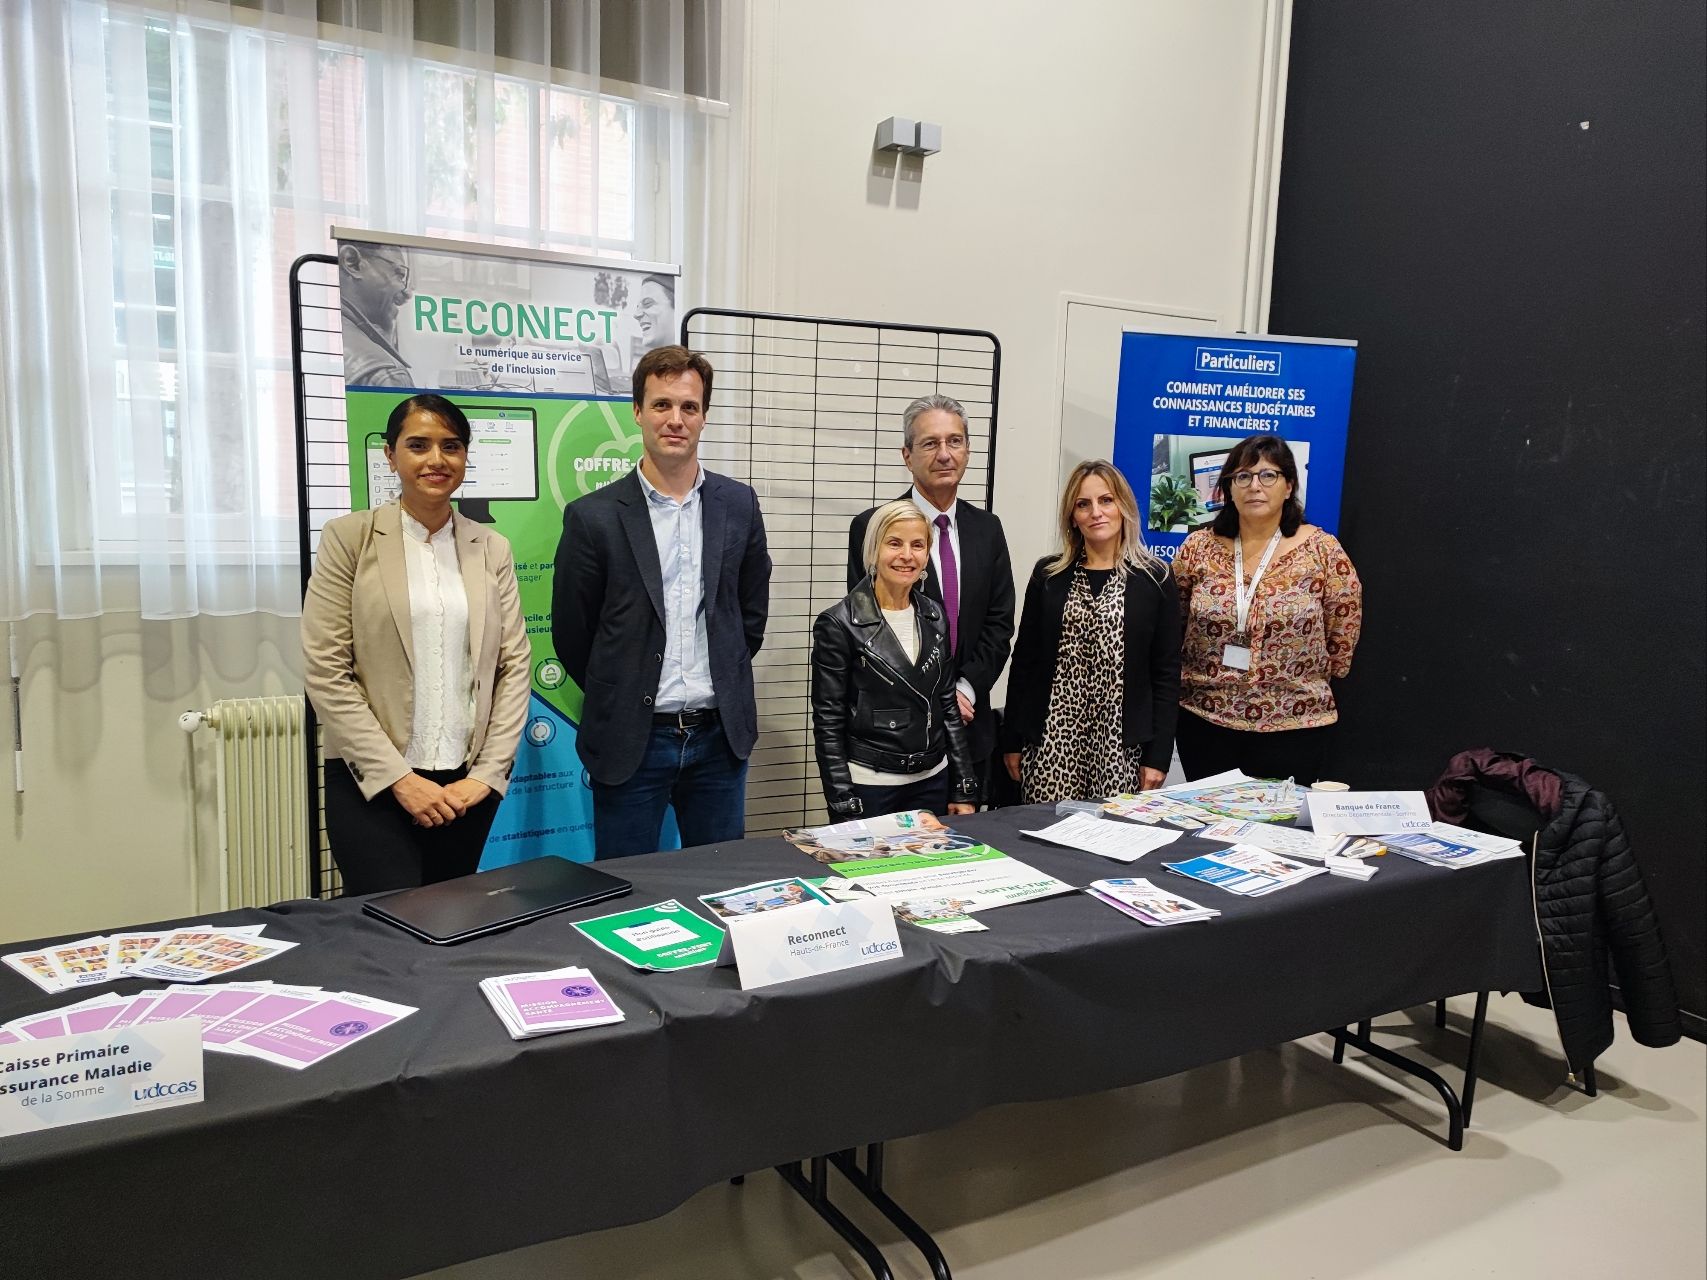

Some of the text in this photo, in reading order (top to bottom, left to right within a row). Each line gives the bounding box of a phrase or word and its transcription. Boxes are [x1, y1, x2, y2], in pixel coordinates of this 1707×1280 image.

[414, 294, 618, 344] RECONNECT
[459, 345, 582, 363] Le numérique au service
[1201, 352, 1276, 372] Particuliers
[491, 363, 556, 376] de l'inclusion
[1166, 381, 1306, 401] COMMENT AMÉLIORER SES
[1152, 397, 1316, 417] CONNAISSANCES BUDGÉTAIRES
[1188, 415, 1279, 431] ET FINANCIÈRES ?
[534, 782, 574, 792] structure
[489, 835, 501, 843] de
[502, 827, 556, 842] statistiques
[787, 925, 847, 946] Reconnect
[790, 938, 850, 957] Hauts-de-France
[56, 1043, 130, 1065] Primaire
[85, 1060, 153, 1081] Maladie
[21, 1085, 105, 1107] de la Somme
